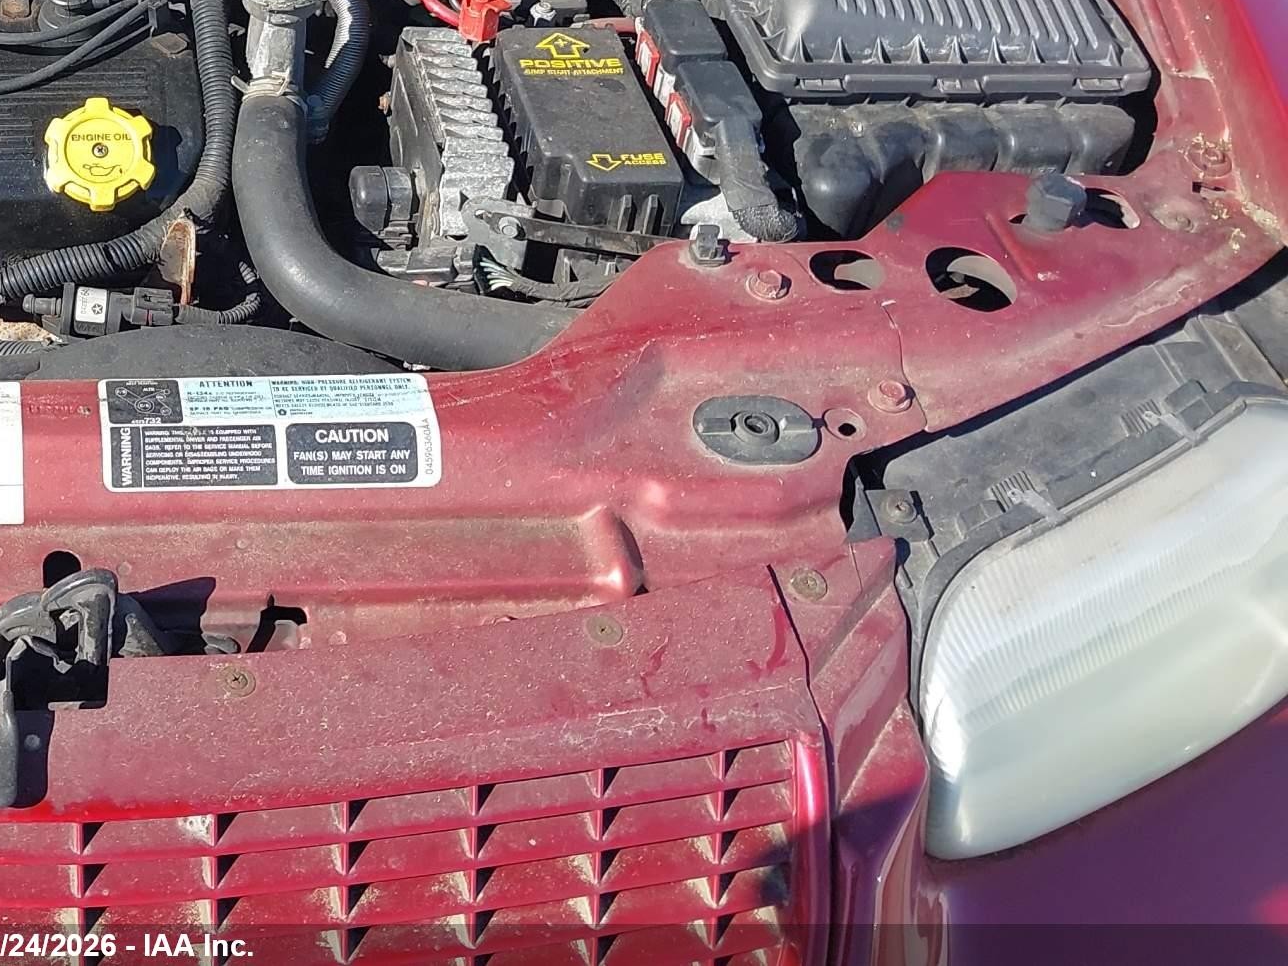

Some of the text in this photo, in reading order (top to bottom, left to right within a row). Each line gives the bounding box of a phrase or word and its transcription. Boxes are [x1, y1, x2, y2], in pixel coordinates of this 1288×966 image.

[519, 58, 622, 68] POSITIVE
[72, 133, 132, 142] ENGINE OIL
[620, 153, 665, 161] FUSE
[199, 380, 253, 388] ATTENTION
[315, 428, 389, 444] CAUTION
[120, 427, 133, 486] WARNING
[293, 449, 411, 461] FAN(S) MAY START ANY
[301, 464, 407, 476] TIME IGNITION IS ON
